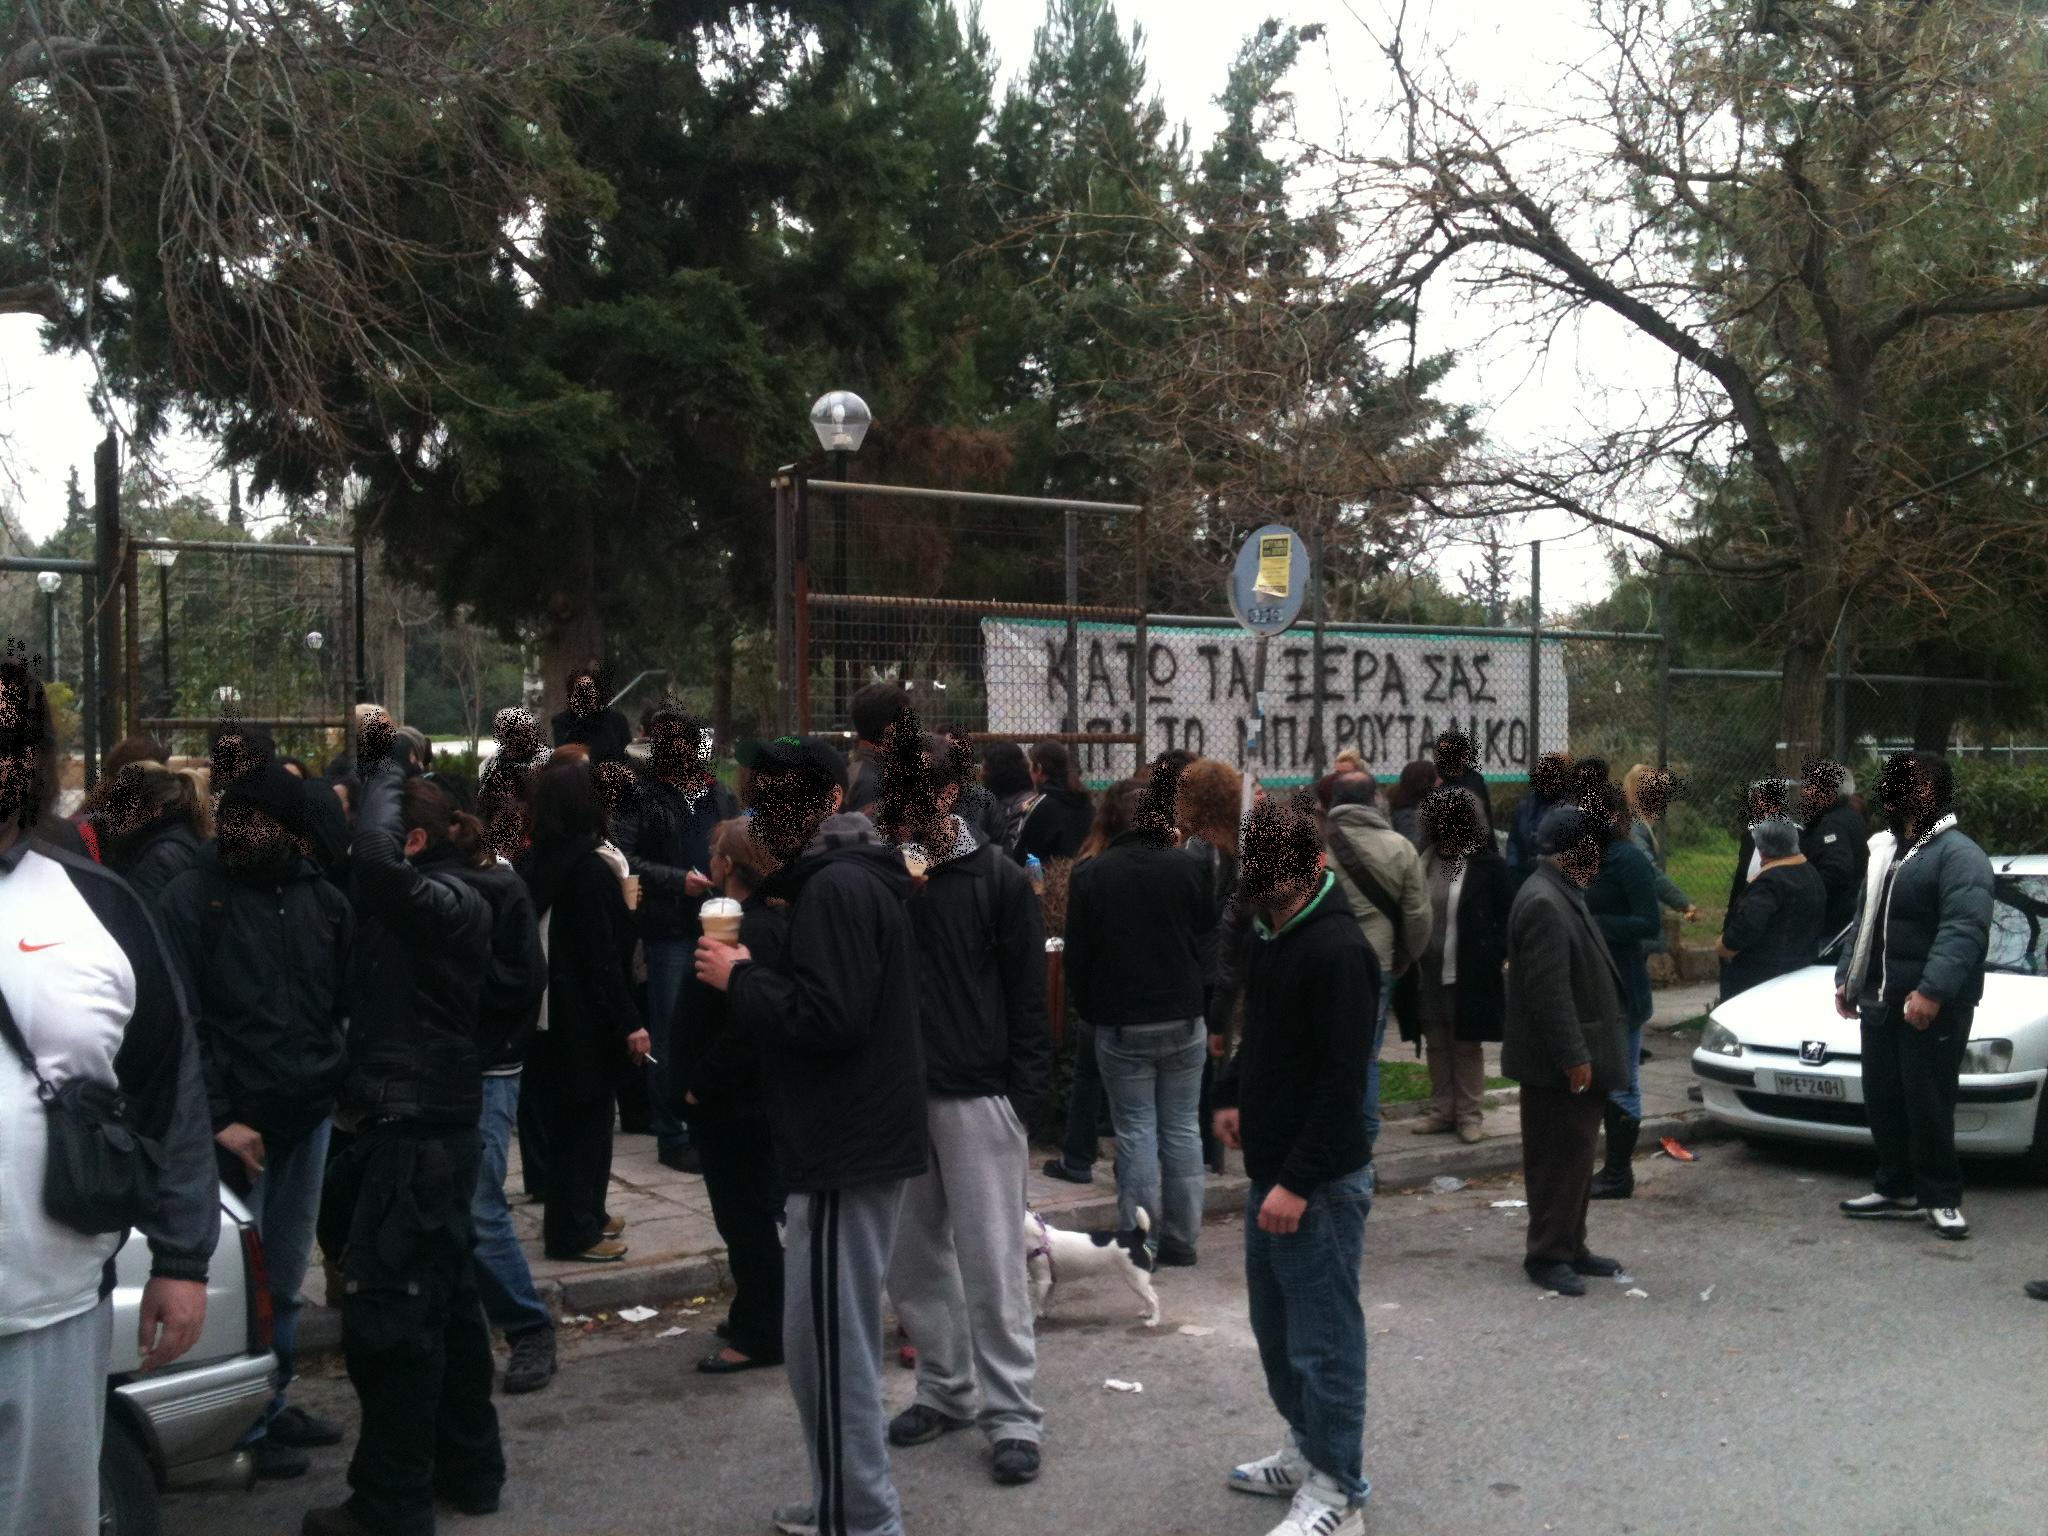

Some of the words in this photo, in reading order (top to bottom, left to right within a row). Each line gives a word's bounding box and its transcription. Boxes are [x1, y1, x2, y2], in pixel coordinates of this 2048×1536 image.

[1046, 639, 1177, 705] ΚΑΤΩ
[1198, 645, 1251, 702] ΤΑ
[1284, 644, 1406, 705] ΞΕΡΑ
[1423, 651, 1497, 705] ΣΑΣ
